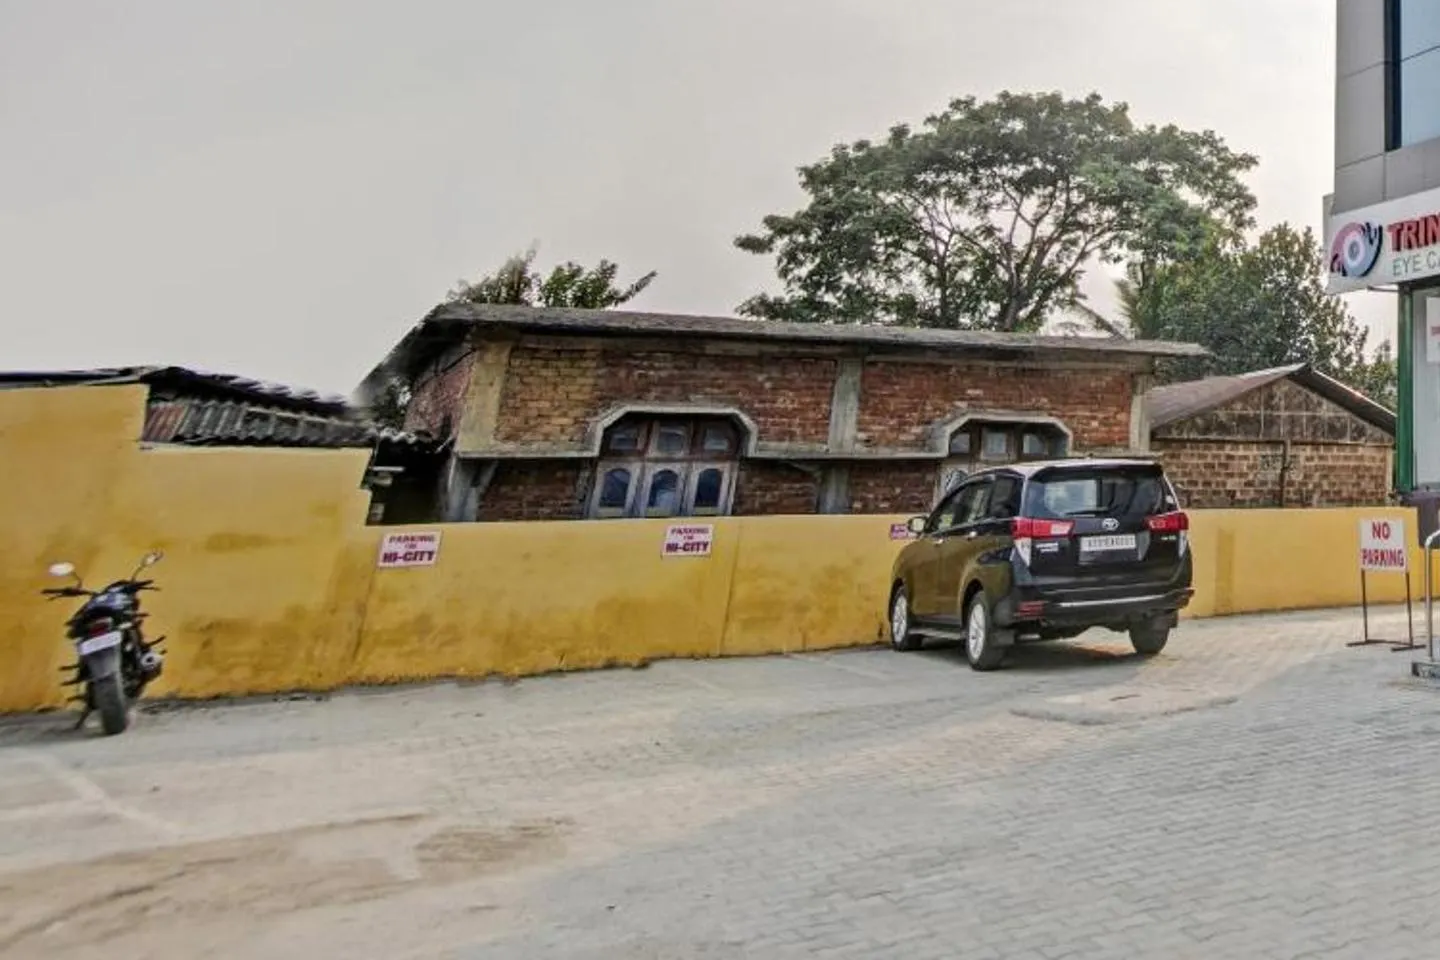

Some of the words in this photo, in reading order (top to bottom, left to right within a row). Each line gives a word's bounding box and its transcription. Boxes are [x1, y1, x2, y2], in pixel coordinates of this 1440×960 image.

[1392, 253, 1423, 277] EYE
[1371, 521, 1391, 540] NO
[665, 541, 709, 552] HI-CITY
[383, 550, 435, 563] HI-CITY
[1361, 548, 1405, 567] PARKING
